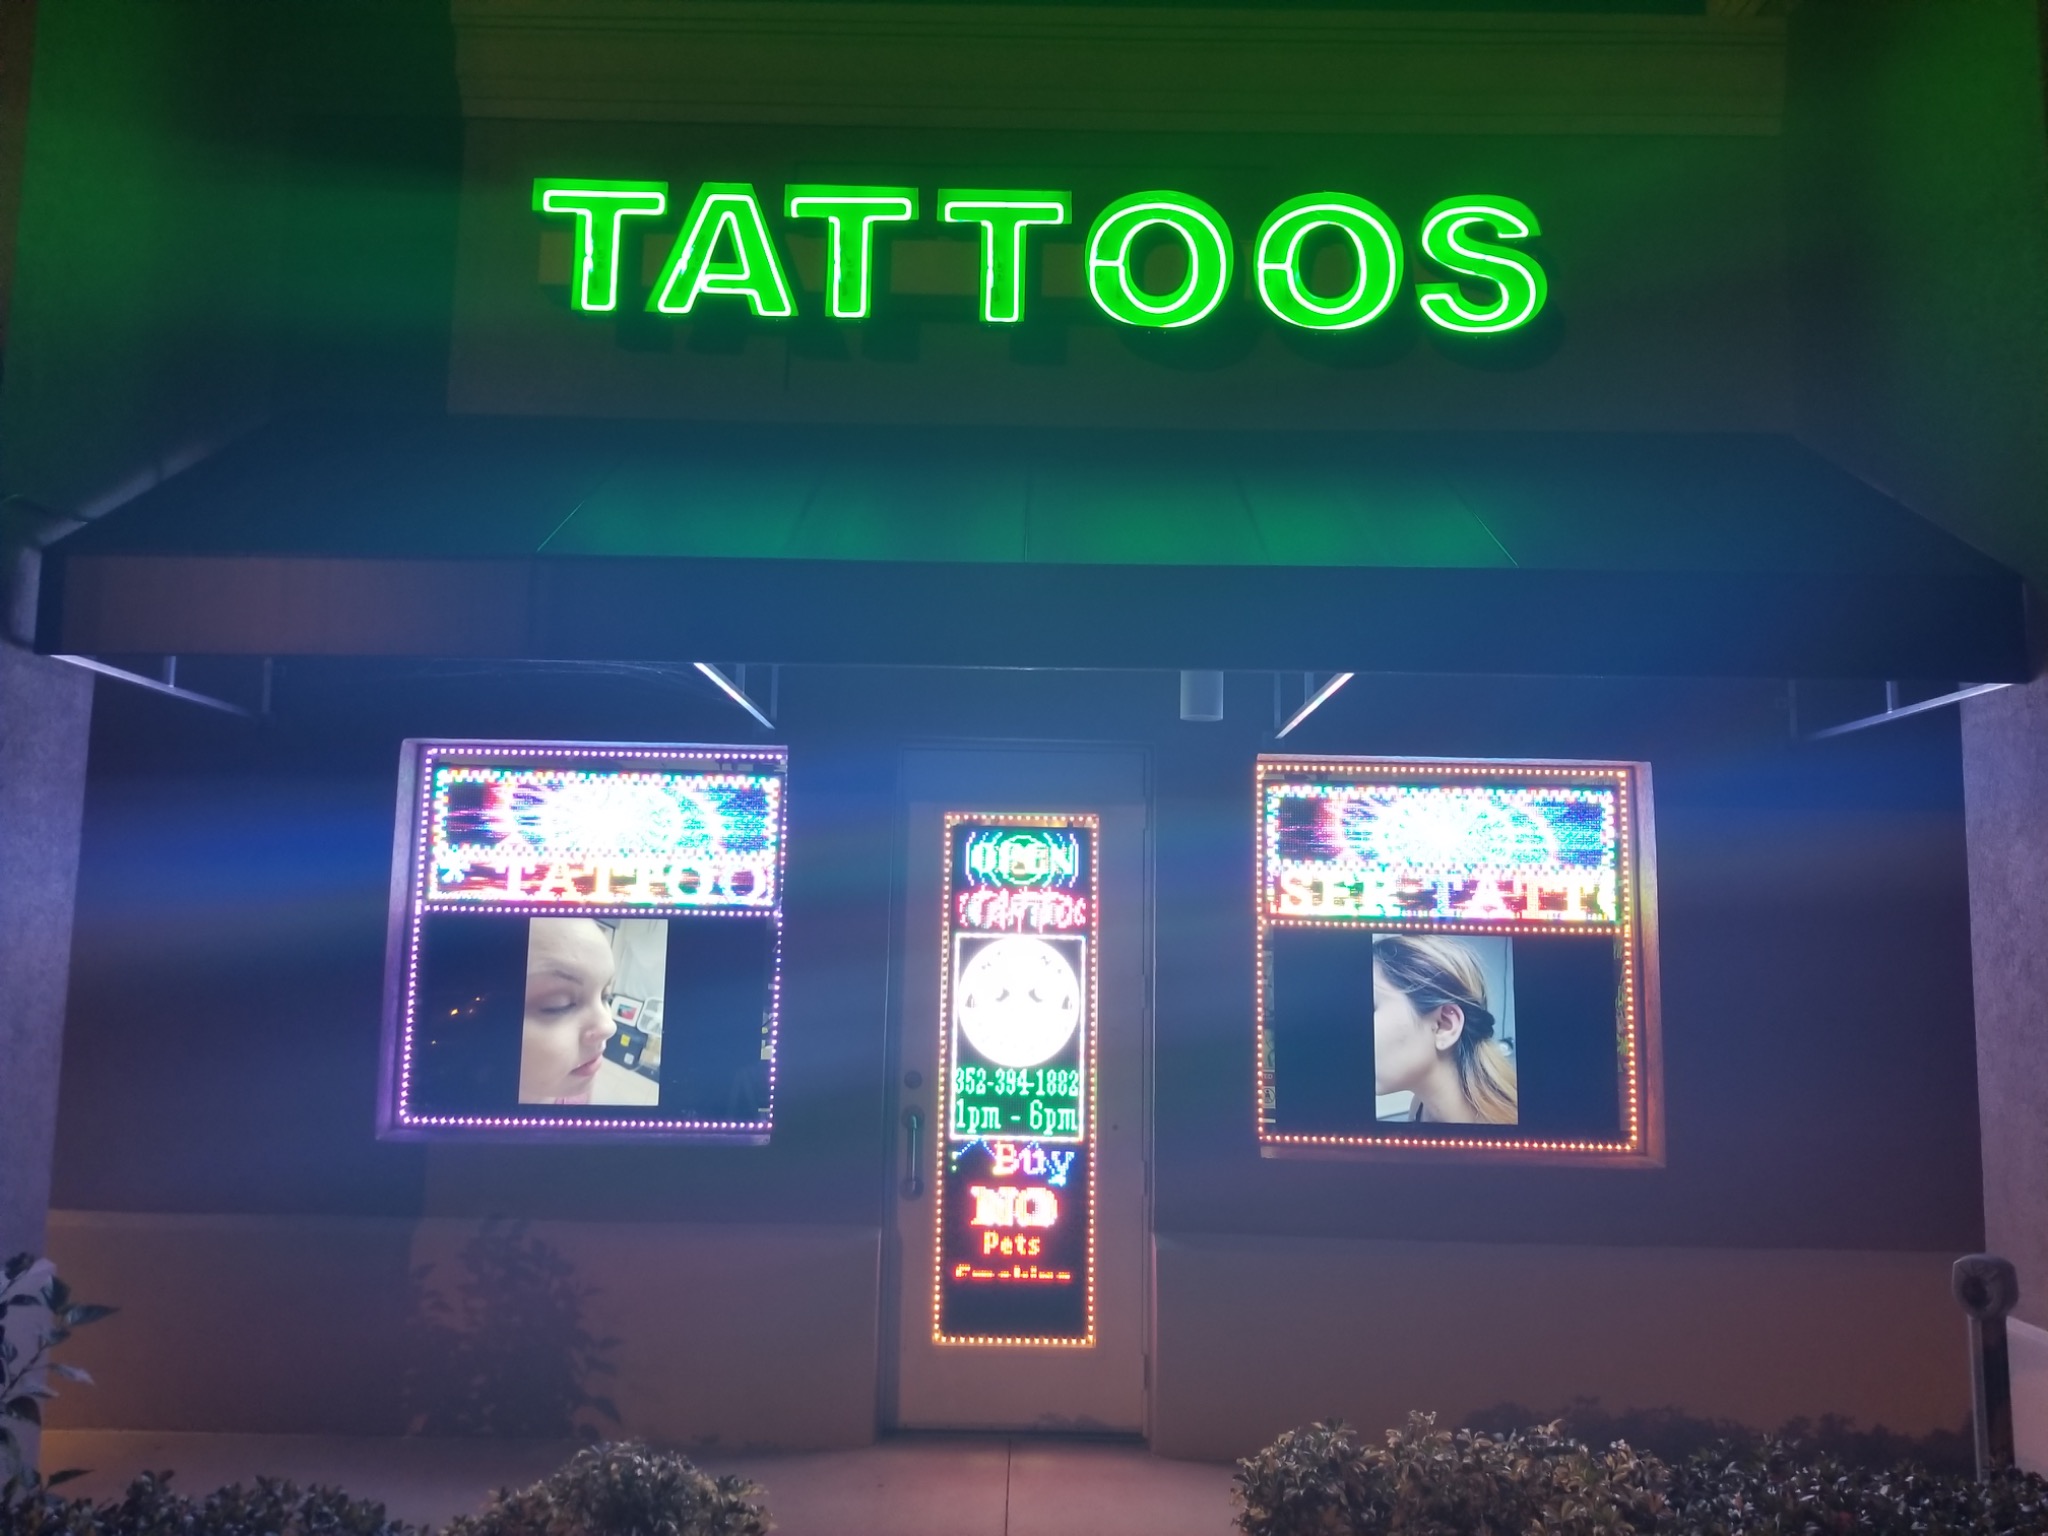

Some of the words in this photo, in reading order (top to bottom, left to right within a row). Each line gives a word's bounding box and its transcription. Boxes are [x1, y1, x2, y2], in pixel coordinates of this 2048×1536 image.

[533, 177, 1548, 335] TATTOOS
[955, 1067, 1079, 1097] 352-394-1882
[956, 1098, 1002, 1134] 1pm
[1029, 1099, 1079, 1136] 6pm
[992, 1142, 1075, 1186] Buy
[970, 1186, 1058, 1228] NO
[983, 1230, 1041, 1255] Pets
